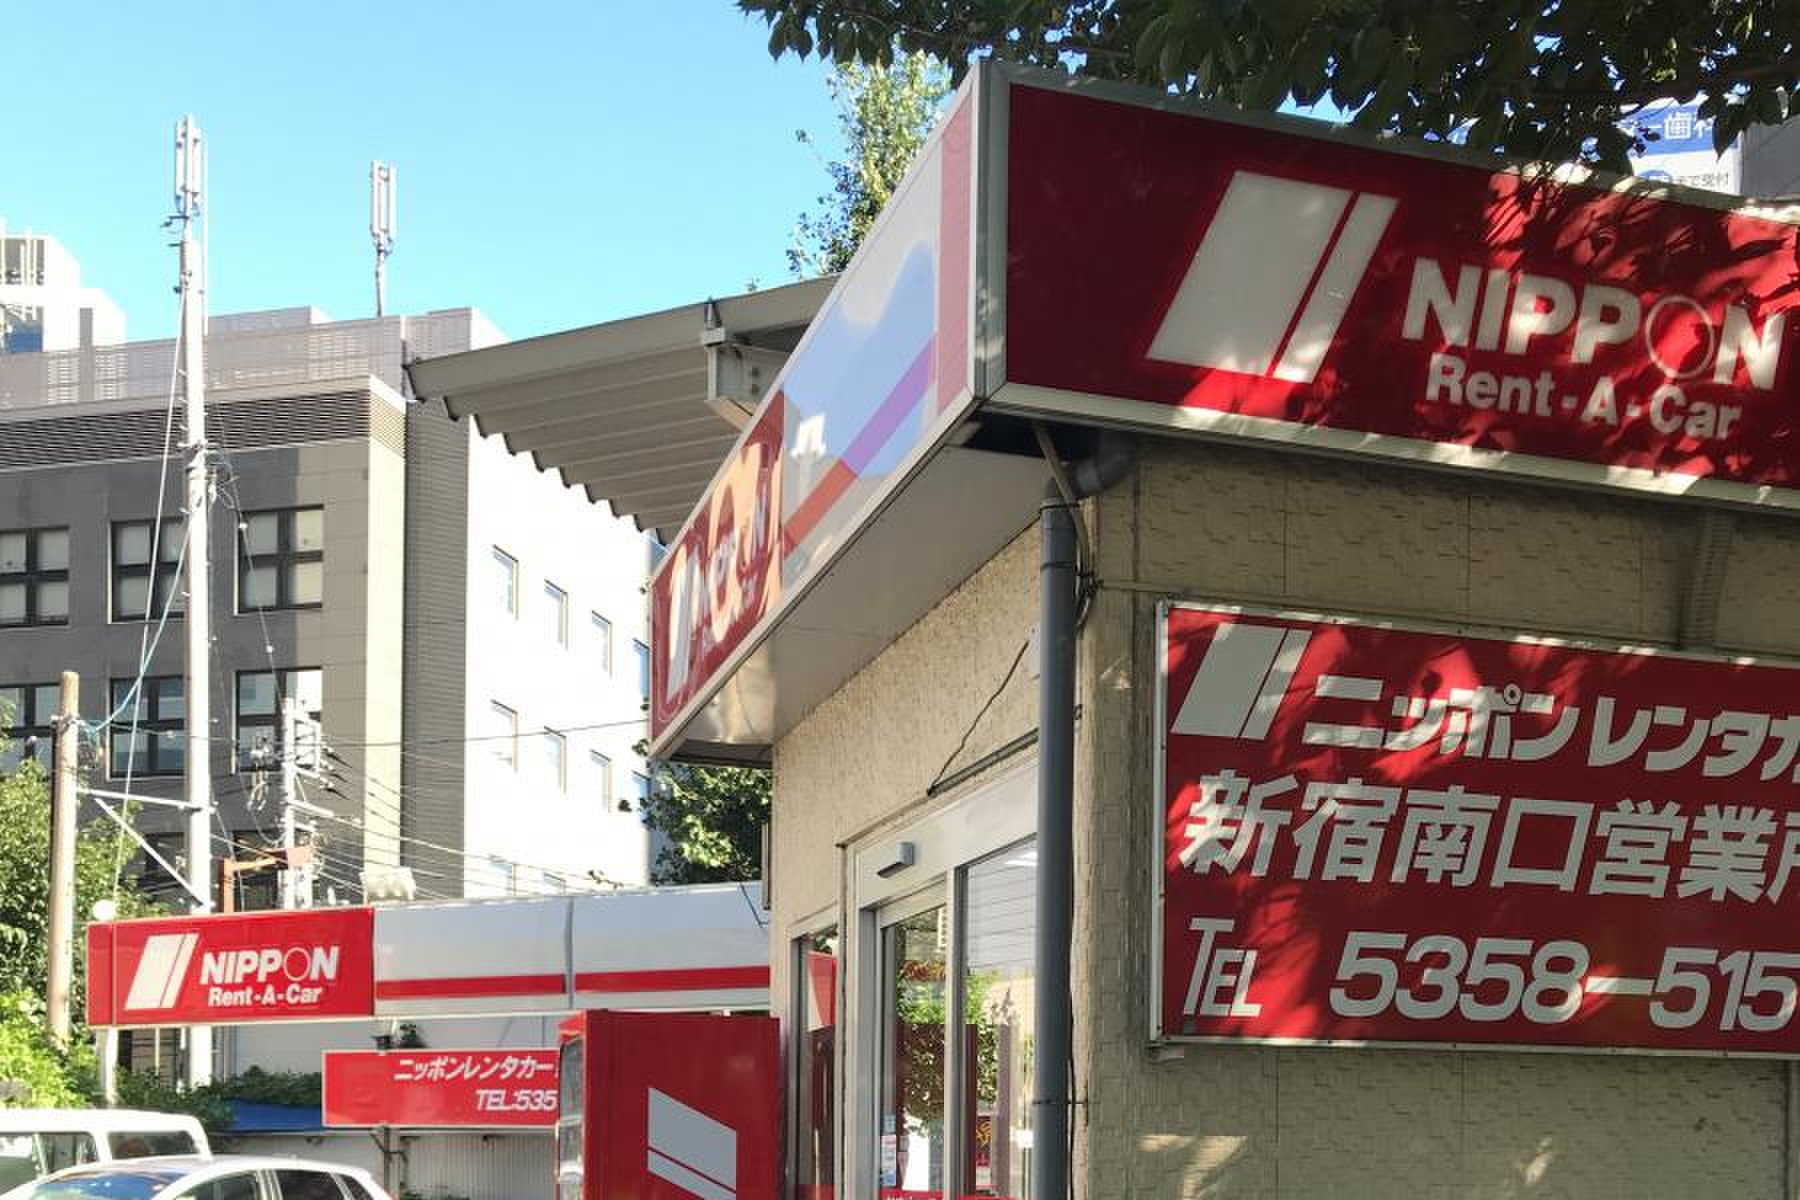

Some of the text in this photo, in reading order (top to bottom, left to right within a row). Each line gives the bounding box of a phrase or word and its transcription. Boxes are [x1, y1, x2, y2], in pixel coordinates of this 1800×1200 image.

[1402, 257, 1784, 390] NIPPON
[200, 946, 339, 985] NIPPON
[1183, 917, 1262, 1018] TEL
[394, 1056, 559, 1081] ニッポンレンタカー
